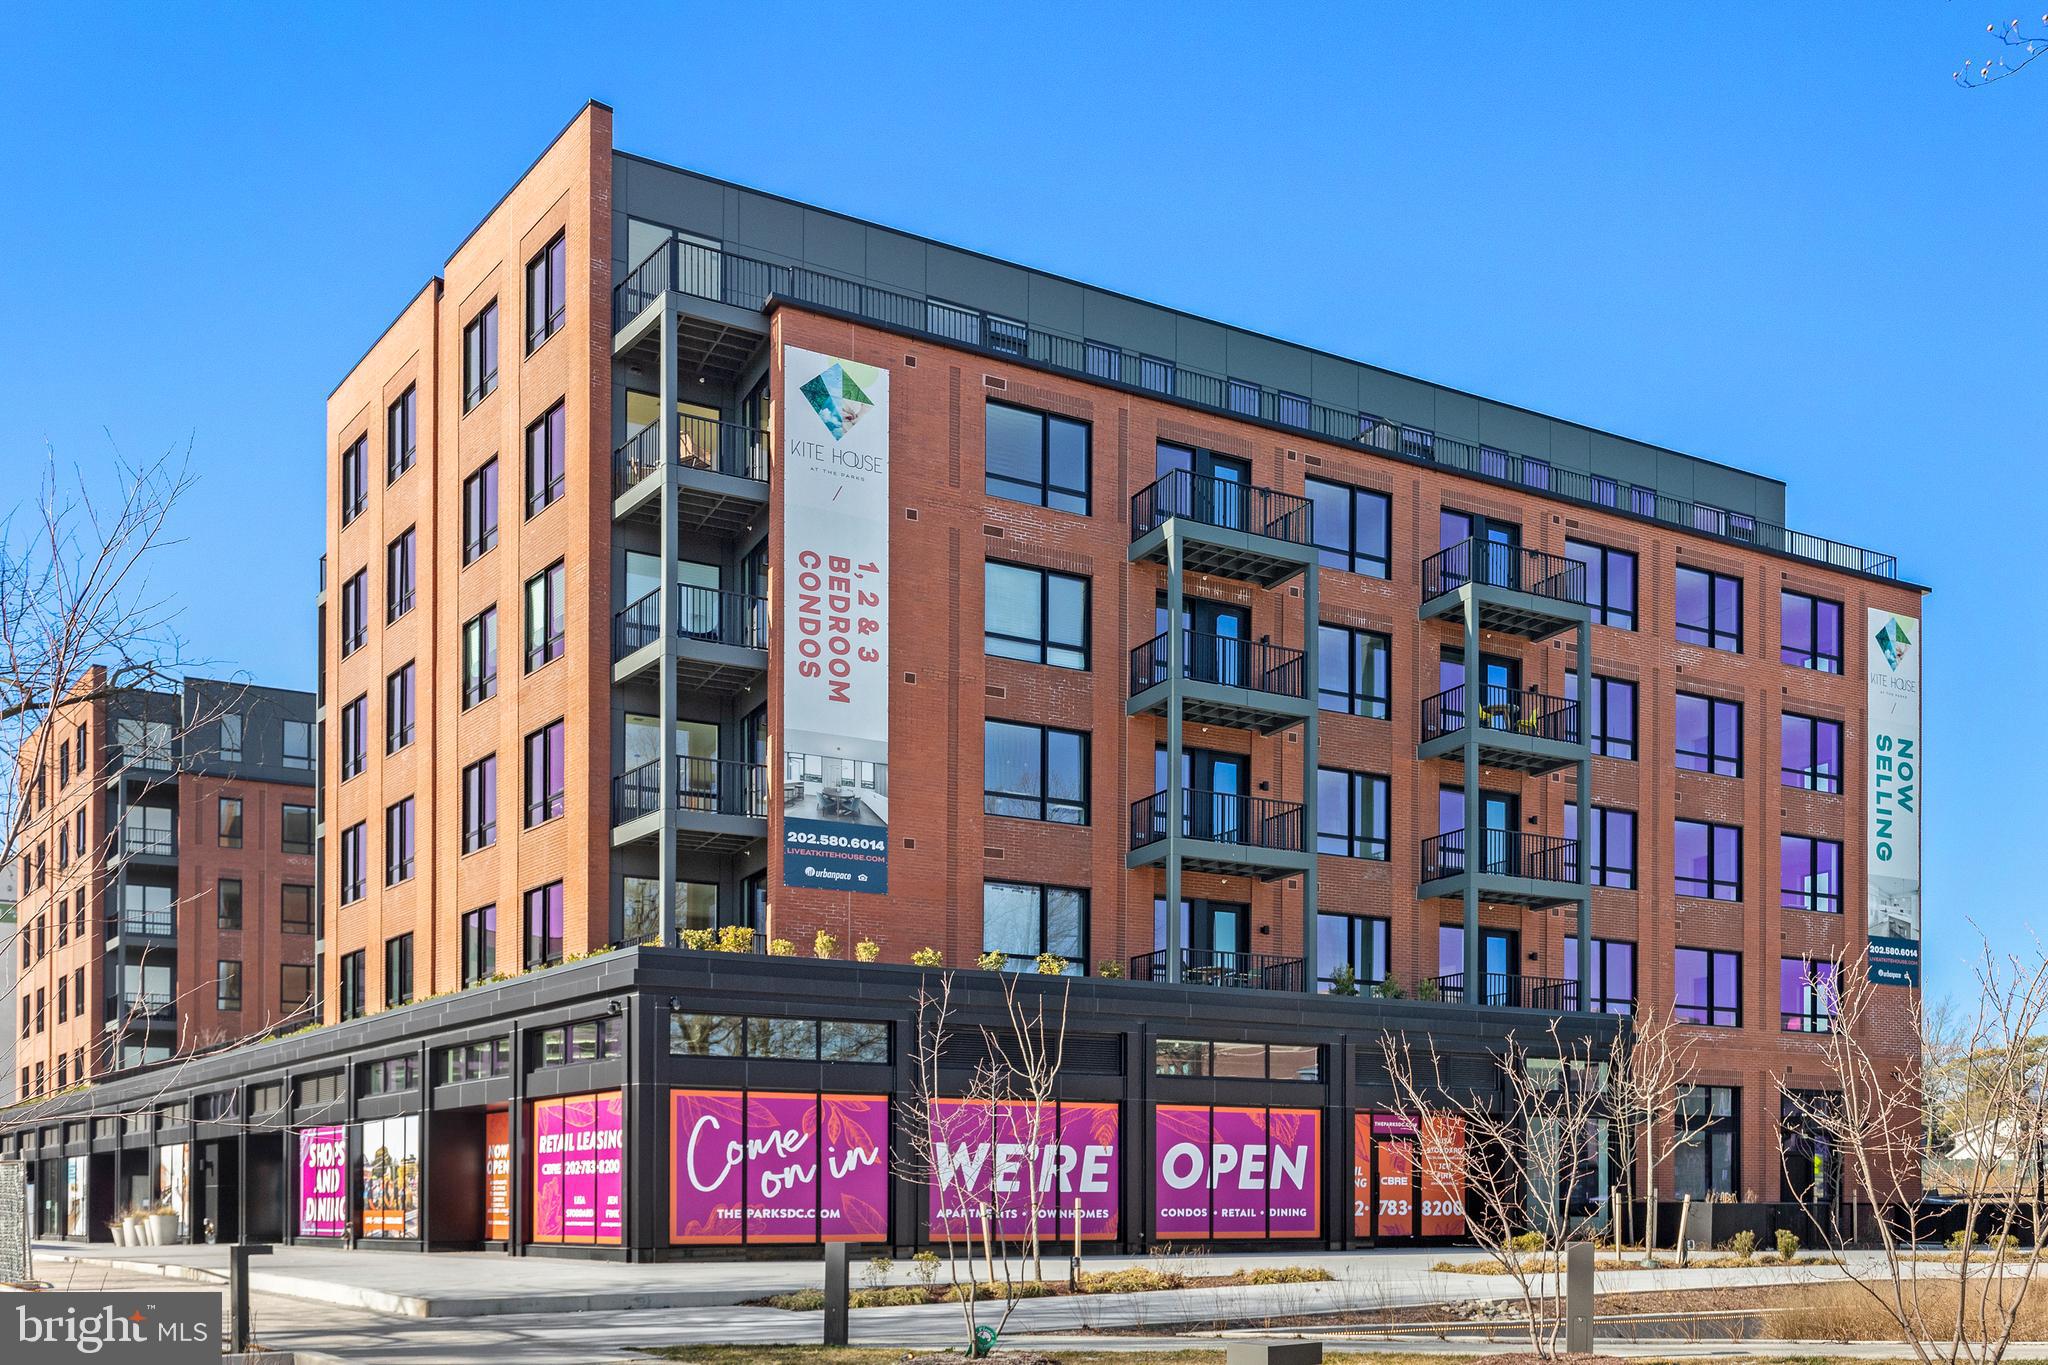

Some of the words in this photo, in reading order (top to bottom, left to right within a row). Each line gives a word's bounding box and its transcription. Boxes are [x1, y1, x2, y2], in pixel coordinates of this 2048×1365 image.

[791, 439, 824, 462] KITE
[832, 448, 883, 474] HOUSE
[841, 472, 865, 481] PARKS
[854, 562, 880, 579] 1,
[858, 590, 880, 608] 2
[799, 550, 822, 678] CONDOS
[828, 555, 851, 703] BEDROOM
[858, 617, 880, 636] &
[858, 646, 880, 663] 3
[1870, 672, 1888, 687] KITE
[1890, 676, 1916, 693] HOUSE
[1897, 738, 1914, 813] NOW
[1876, 734, 1893, 861] SELLING
[787, 831, 885, 851] 202.580.6014
[786, 848, 885, 863] LIVEATKITEHOUSE.COM
[815, 868, 852, 881] urbanpace
[1869, 945, 1918, 957] 202.580.6014
[487, 1143, 509, 1159] NOW
[539, 1132, 575, 1153] RETAIL
[686, 1115, 809, 1193] Come
[486, 1160, 510, 1175] OPEN
[760, 1163, 817, 1198] on
[827, 1146, 879, 1179] in
[935, 1142, 1114, 1193] WE'RE
[1161, 1142, 1308, 1191] OPEN
[313, 1168, 340, 1193] AND
[1380, 1176, 1409, 1185] CBRE
[1160, 1207, 1208, 1218] CONDOS
[1221, 1208, 1257, 1218] RETAIL
[1269, 1208, 1307, 1218] DINING
